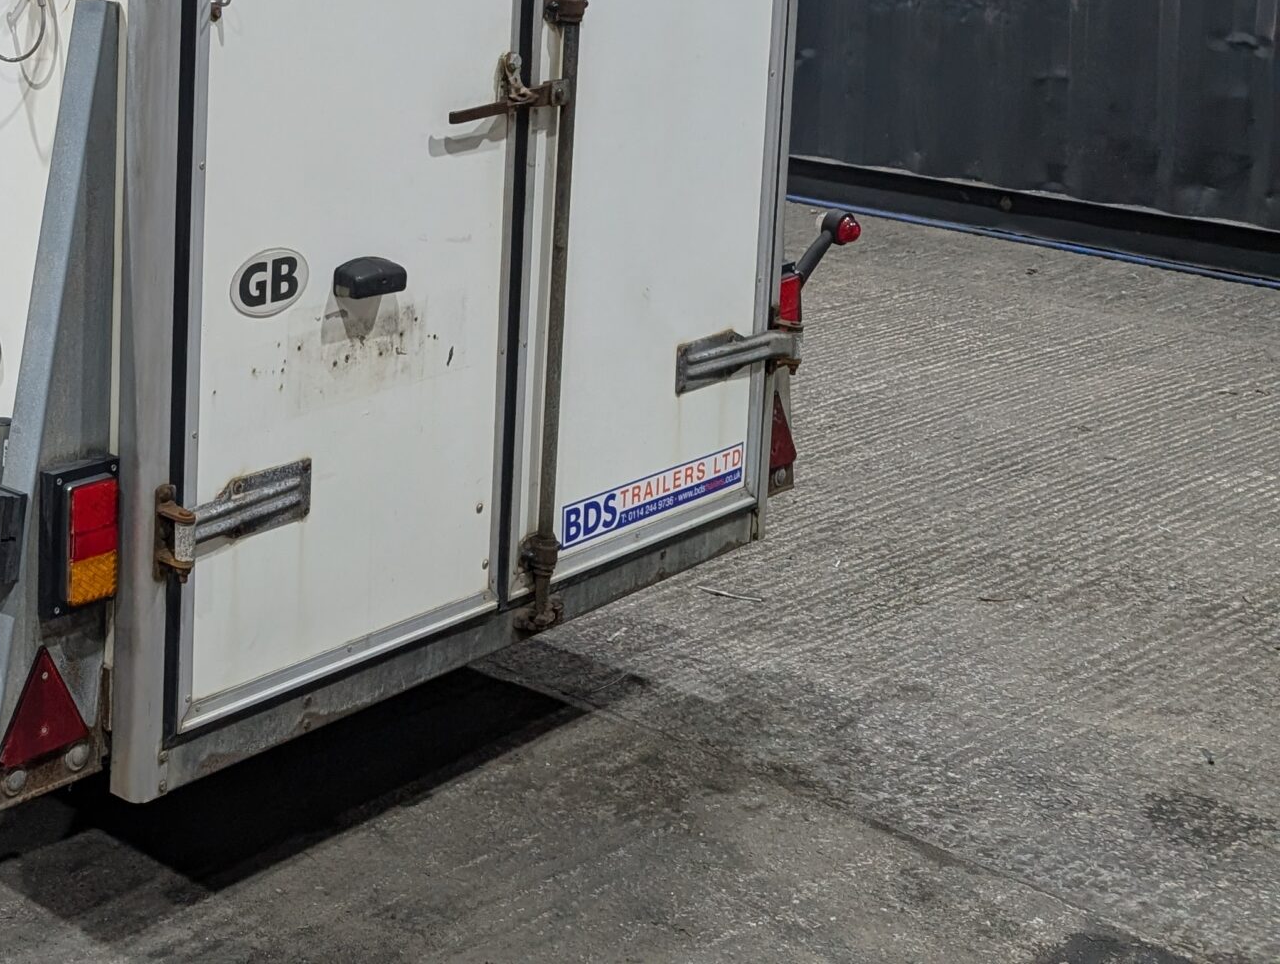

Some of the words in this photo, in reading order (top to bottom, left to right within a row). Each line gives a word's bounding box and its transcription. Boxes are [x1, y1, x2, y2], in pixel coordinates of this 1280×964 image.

[239, 256, 299, 308] GB
[565, 493, 617, 543] BDS
[620, 461, 706, 508] TRAILERS
[713, 448, 742, 475] LTD
[628, 509, 644, 522] 0114
[645, 503, 658, 516] 244
[677, 469, 741, 502] www.bds.co.uk
